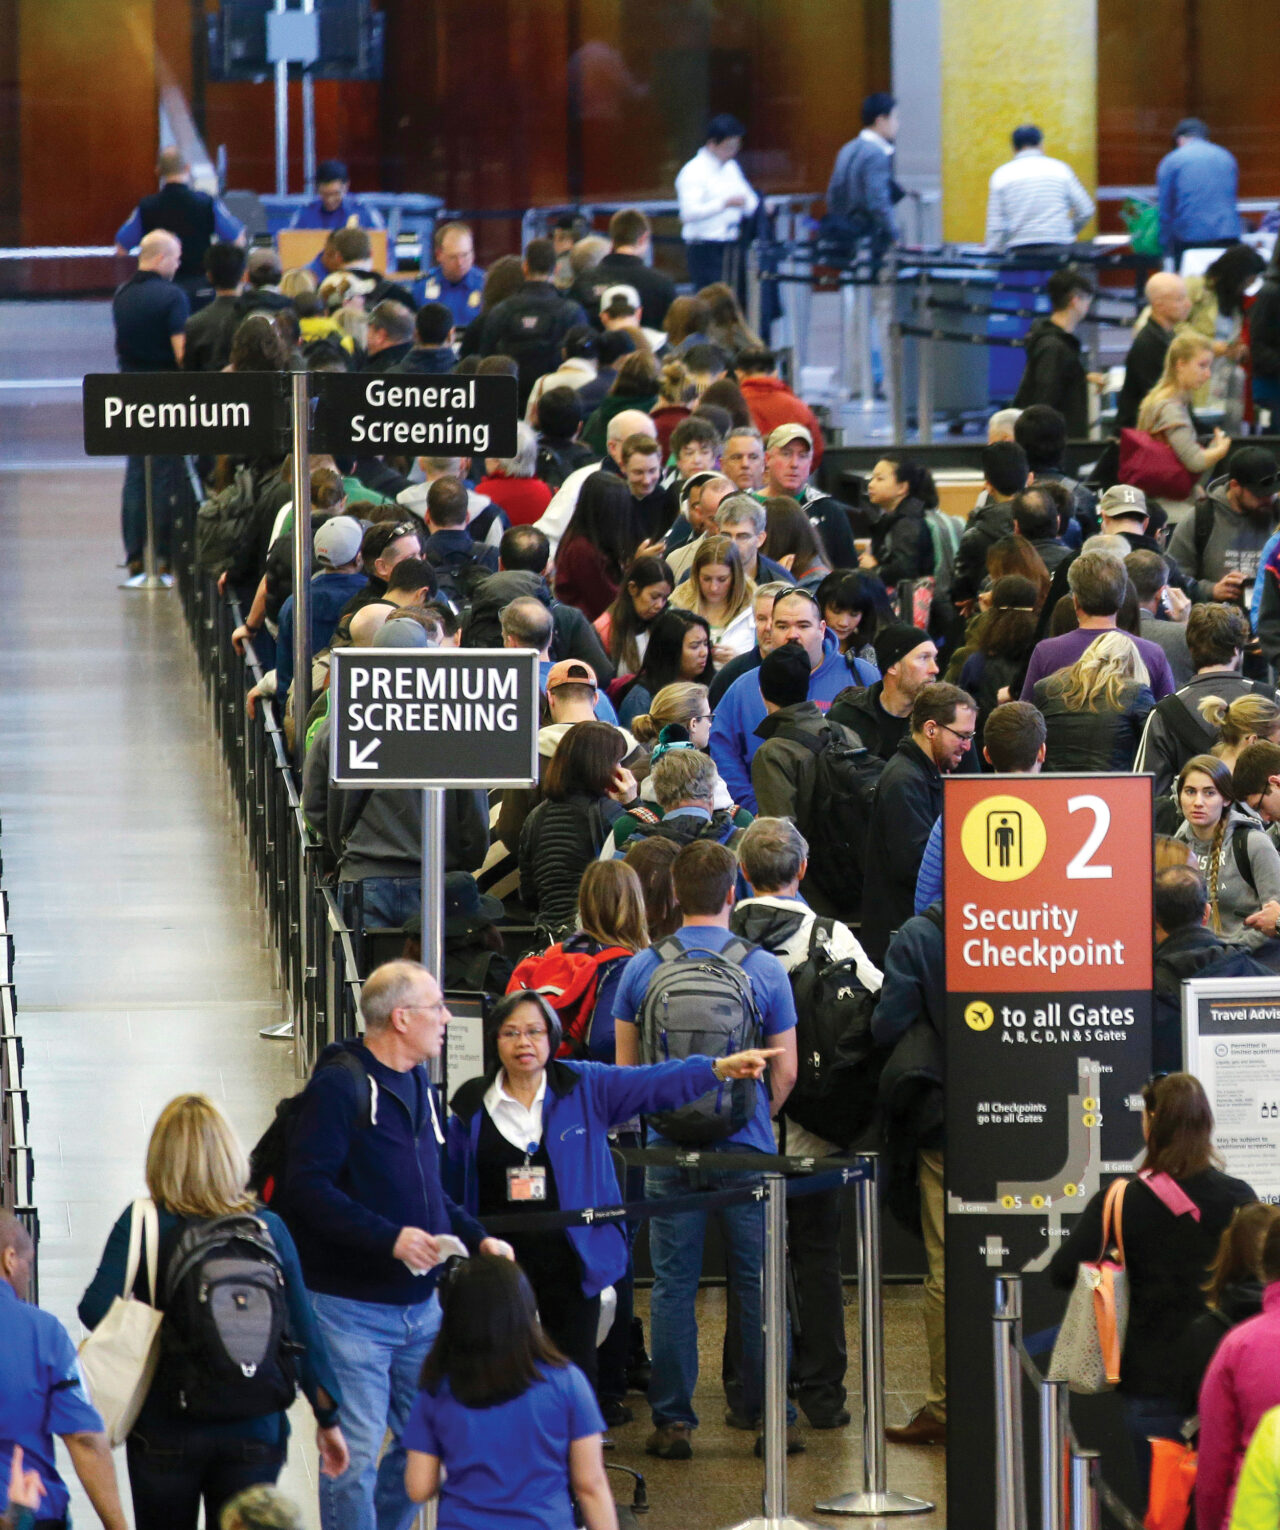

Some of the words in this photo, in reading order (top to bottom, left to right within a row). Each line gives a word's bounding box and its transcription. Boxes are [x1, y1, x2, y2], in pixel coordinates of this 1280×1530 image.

[365, 379, 476, 409] General
[104, 395, 250, 429] Premium
[351, 415, 490, 452] Screening
[350, 667, 518, 700] PREMIUM
[348, 703, 518, 732] SCREENING
[1066, 794, 1113, 879] 2
[962, 902, 1079, 938] Security
[962, 937, 1125, 974] Checkpoint
[1001, 1006, 1027, 1027] to
[1033, 1003, 1061, 1027] all
[1068, 1004, 1135, 1027] Gates
[1211, 1009, 1247, 1021] Travel
[1001, 1031, 1014, 1044] A,
[1016, 1031, 1029, 1044] B,
[1030, 1031, 1043, 1044] C,
[1045, 1031, 1058, 1043] D,
[1060, 1030, 1070, 1042] N
[1072, 1030, 1082, 1042] &
[1085, 1030, 1092, 1041] S
[1094, 1029, 1127, 1041] Gates
[1083, 1065, 1090, 1073] A
[1091, 1065, 1113, 1073] Gates
[977, 1102, 990, 1113] All
[991, 1102, 1047, 1116] Checkpoints
[1095, 1098, 1102, 1110] 1
[1124, 1098, 1130, 1107] S
[977, 1114, 990, 1125] go
[991, 1114, 1002, 1123] to
[1003, 1113, 1015, 1123] all
[1016, 1113, 1043, 1123] Gates
[1096, 1114, 1104, 1127] 2
[1104, 1163, 1110, 1171] B
[1112, 1163, 1133, 1171] Gates
[1077, 1185, 1085, 1197] 3
[1014, 1196, 1022, 1209] 5
[1044, 1195, 1052, 1208] 4
[966, 1204, 988, 1213] Gates
[1040, 1228, 1047, 1236] C
[1048, 1228, 1070, 1236] Gates
[979, 1246, 986, 1255] N
[987, 1246, 1010, 1255] Gates
